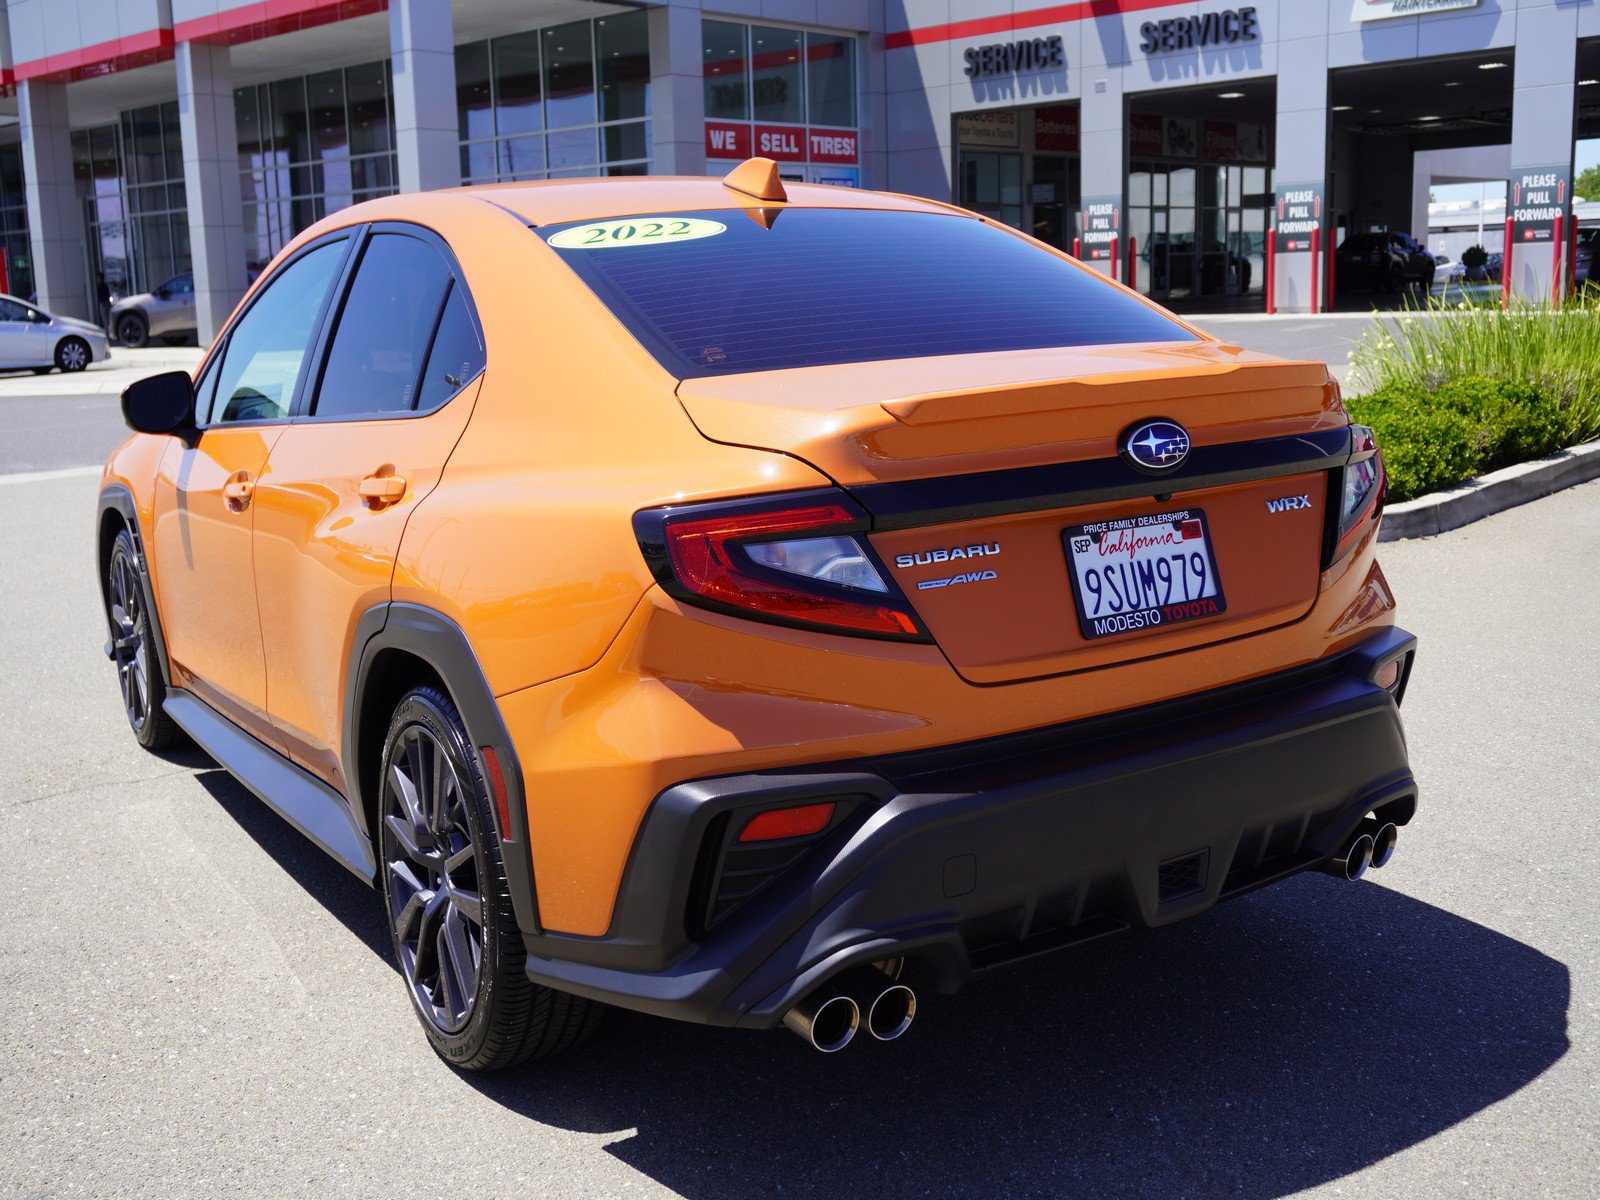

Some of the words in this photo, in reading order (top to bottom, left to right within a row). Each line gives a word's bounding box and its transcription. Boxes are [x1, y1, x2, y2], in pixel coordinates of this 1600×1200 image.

[1140, 7, 1257, 54] SERVICE
[964, 35, 1064, 77] SERVICE
[1037, 118, 1078, 135] Batteries
[710, 130, 736, 150] WE
[760, 133, 799, 153] SELL
[811, 136, 855, 155] TIRES!
[1522, 174, 1556, 188] PLEASE
[1285, 190, 1314, 203] PLEASE
[1527, 191, 1550, 204] PULL
[1089, 203, 1113, 216] PLEASE
[1289, 206, 1309, 218] PULL
[1513, 207, 1563, 222] FORWARD
[1092, 218, 1109, 229] PULL
[1278, 220, 1319, 234] FORWARD
[583, 221, 691, 244] 2022
[1084, 231, 1118, 243] FORWARD
[1265, 494, 1312, 513] WRX
[1084, 523, 1107, 534] PRICE
[1109, 518, 1137, 531] FAMILY
[1138, 511, 1190, 526] DEALERSHIPS
[1074, 538, 1091, 554] SEP
[1098, 527, 1183, 559] California
[896, 542, 1000, 568] SUBARU
[949, 570, 998, 586] AWD
[1085, 552, 1206, 616] 9SUM979
[1094, 609, 1161, 636] MODESTO
[1163, 600, 1217, 622] TOYOTA
